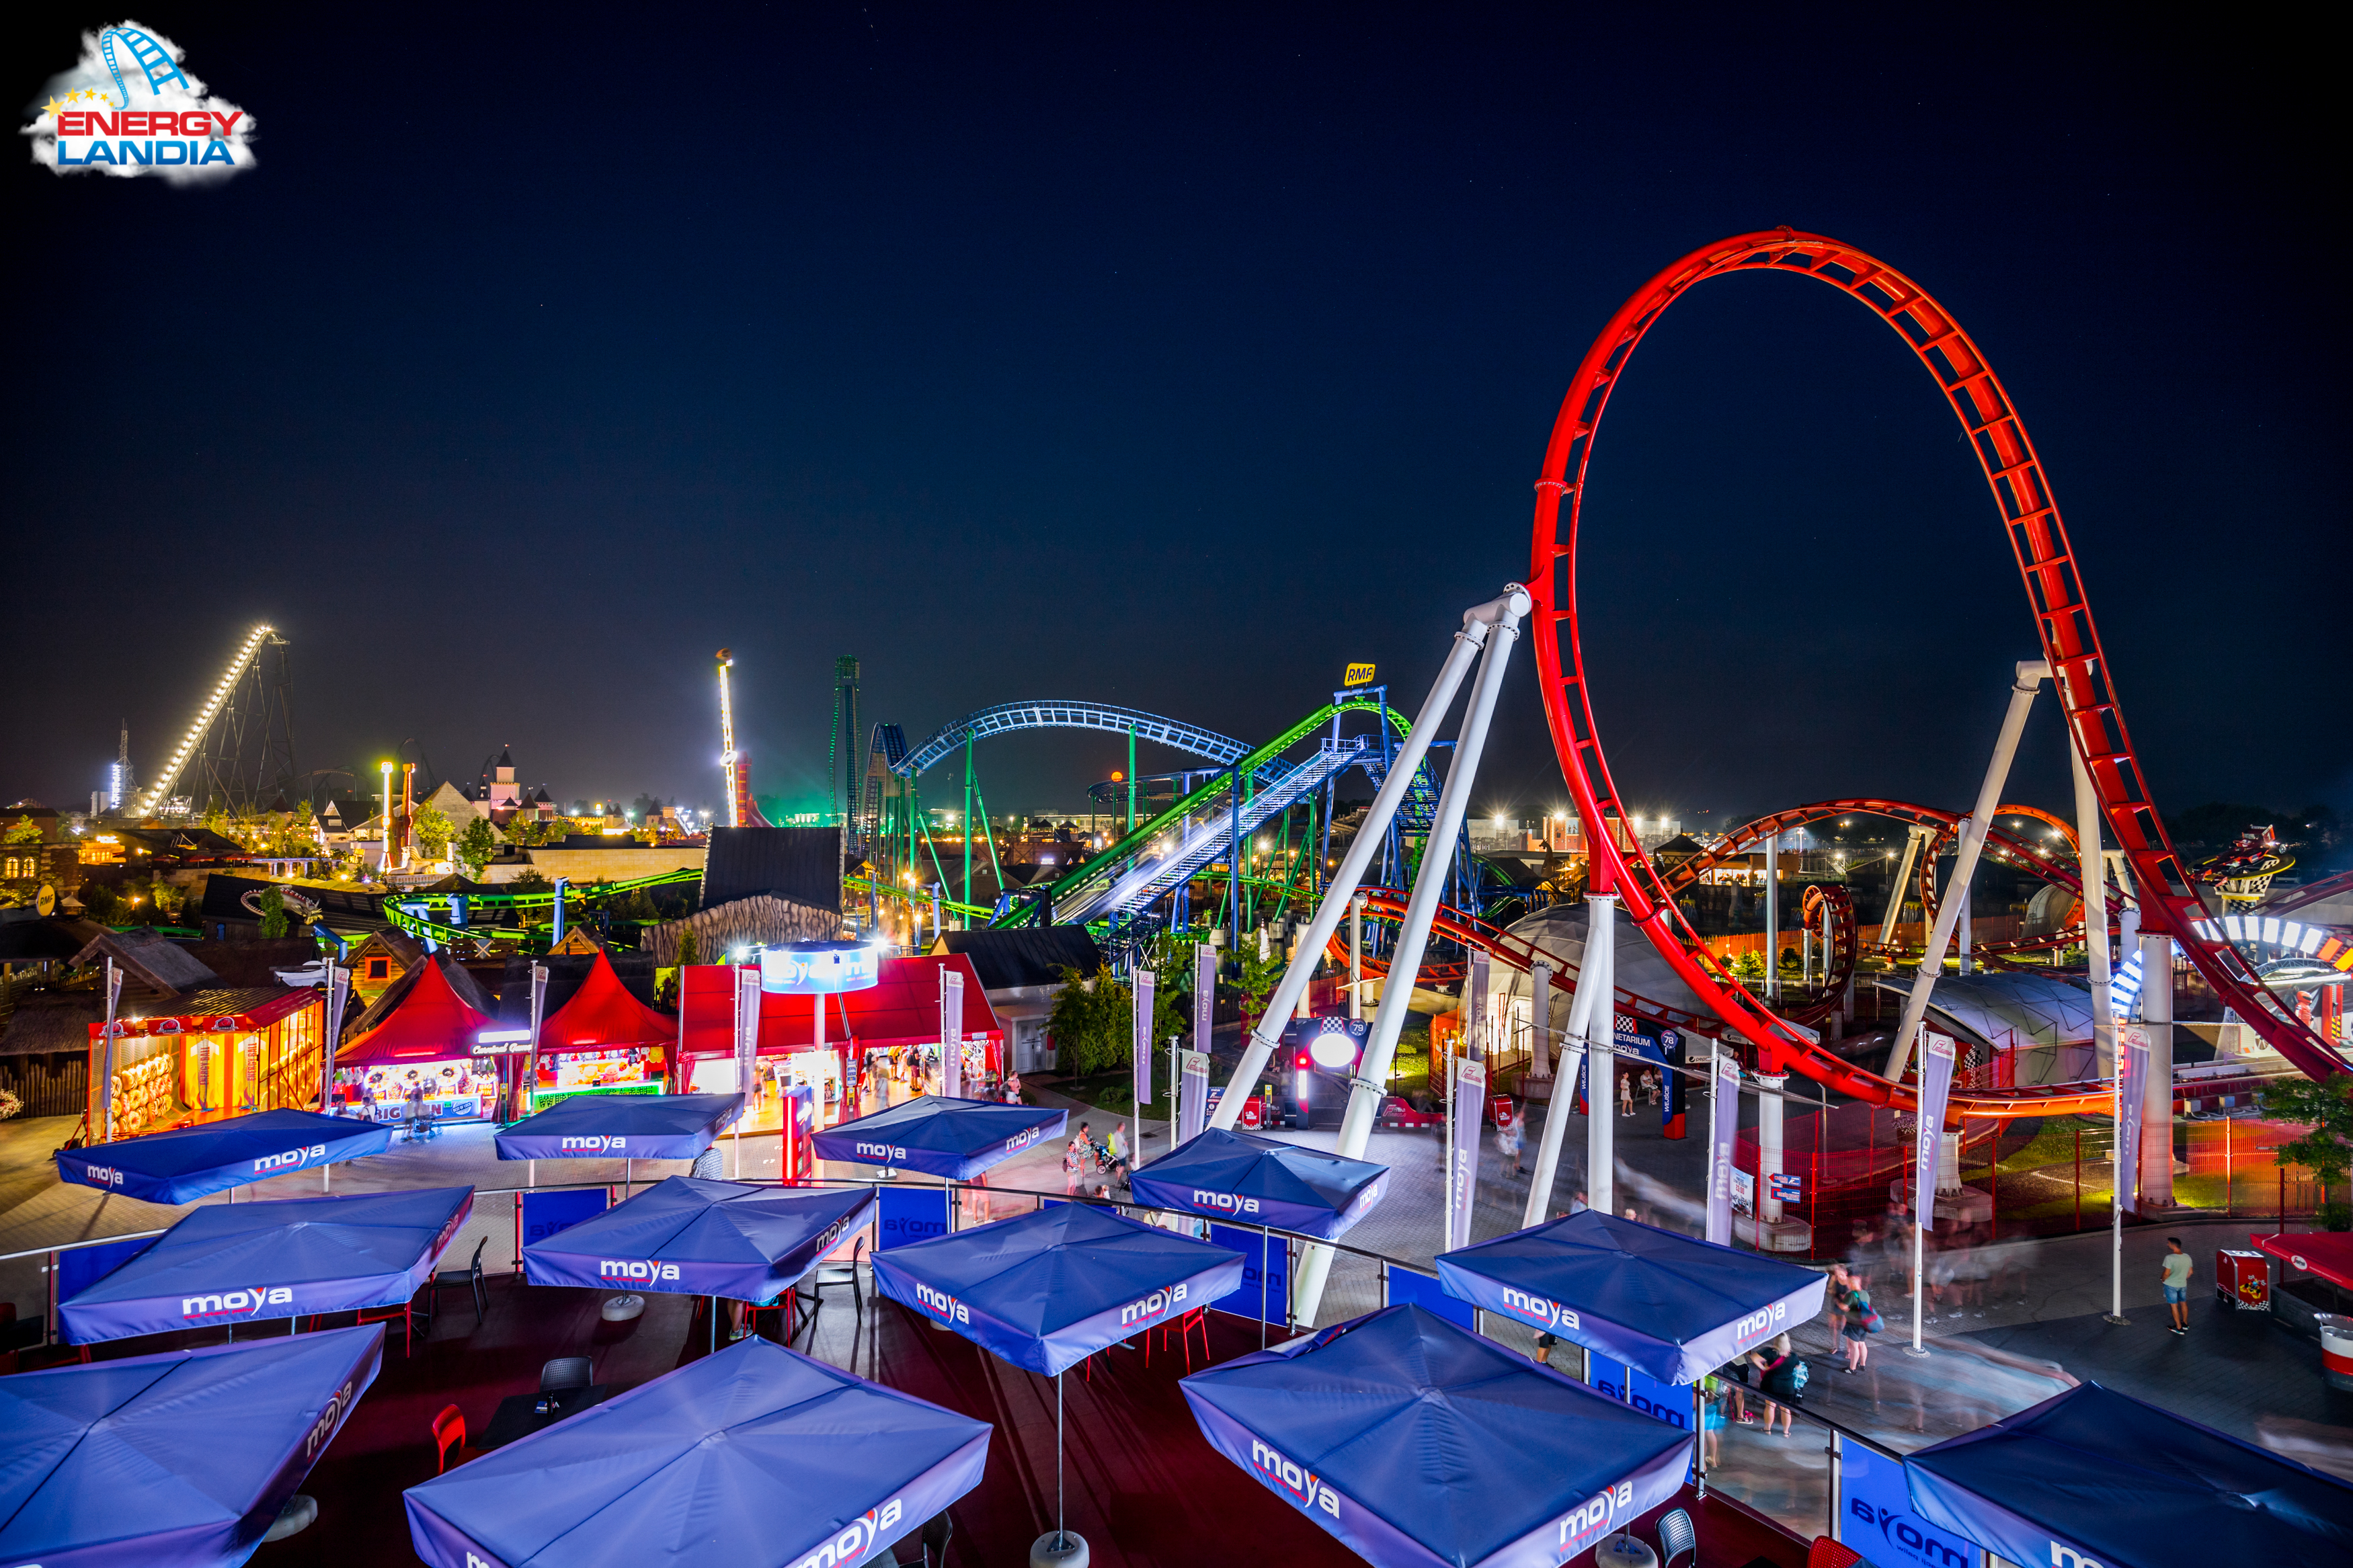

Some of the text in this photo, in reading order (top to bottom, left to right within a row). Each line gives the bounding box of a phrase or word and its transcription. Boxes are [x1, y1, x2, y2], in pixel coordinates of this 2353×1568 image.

[1347, 667, 1373, 682] RMF
[40, 894, 54, 907] RMF
[1202, 990, 1211, 1021] moya
[1353, 1024, 1363, 1032] 79
[1613, 1032, 1650, 1046] NETARIUM
[1664, 1036, 1674, 1044] 78
[950, 1028, 959, 1067] moya
[715, 1108, 732, 1130] moya
[562, 1135, 626, 1154] moya
[1006, 1126, 1039, 1150] moya
[1921, 1114, 1936, 1170] moya
[255, 1145, 325, 1171] moya
[856, 1143, 906, 1163] moya
[88, 1165, 124, 1188] moya
[1455, 1149, 1471, 1209] moya
[1194, 1190, 1259, 1216] moya
[1359, 1184, 1378, 1209] moya
[436, 1214, 458, 1251] moya
[816, 1216, 850, 1252] moya
[601, 1260, 680, 1287] moya
[183, 1287, 292, 1316] moya
[916, 1282, 969, 1324] moya
[1121, 1283, 1187, 1324] moya
[1503, 1287, 1579, 1330] moya
[1737, 1302, 1785, 1339] moya
[307, 1381, 352, 1457] moya
[1252, 1439, 1339, 1519] moya
[1560, 1481, 1632, 1544] moya
[796, 1498, 902, 1568] moya
[844, 1544, 867, 1565] paliw
